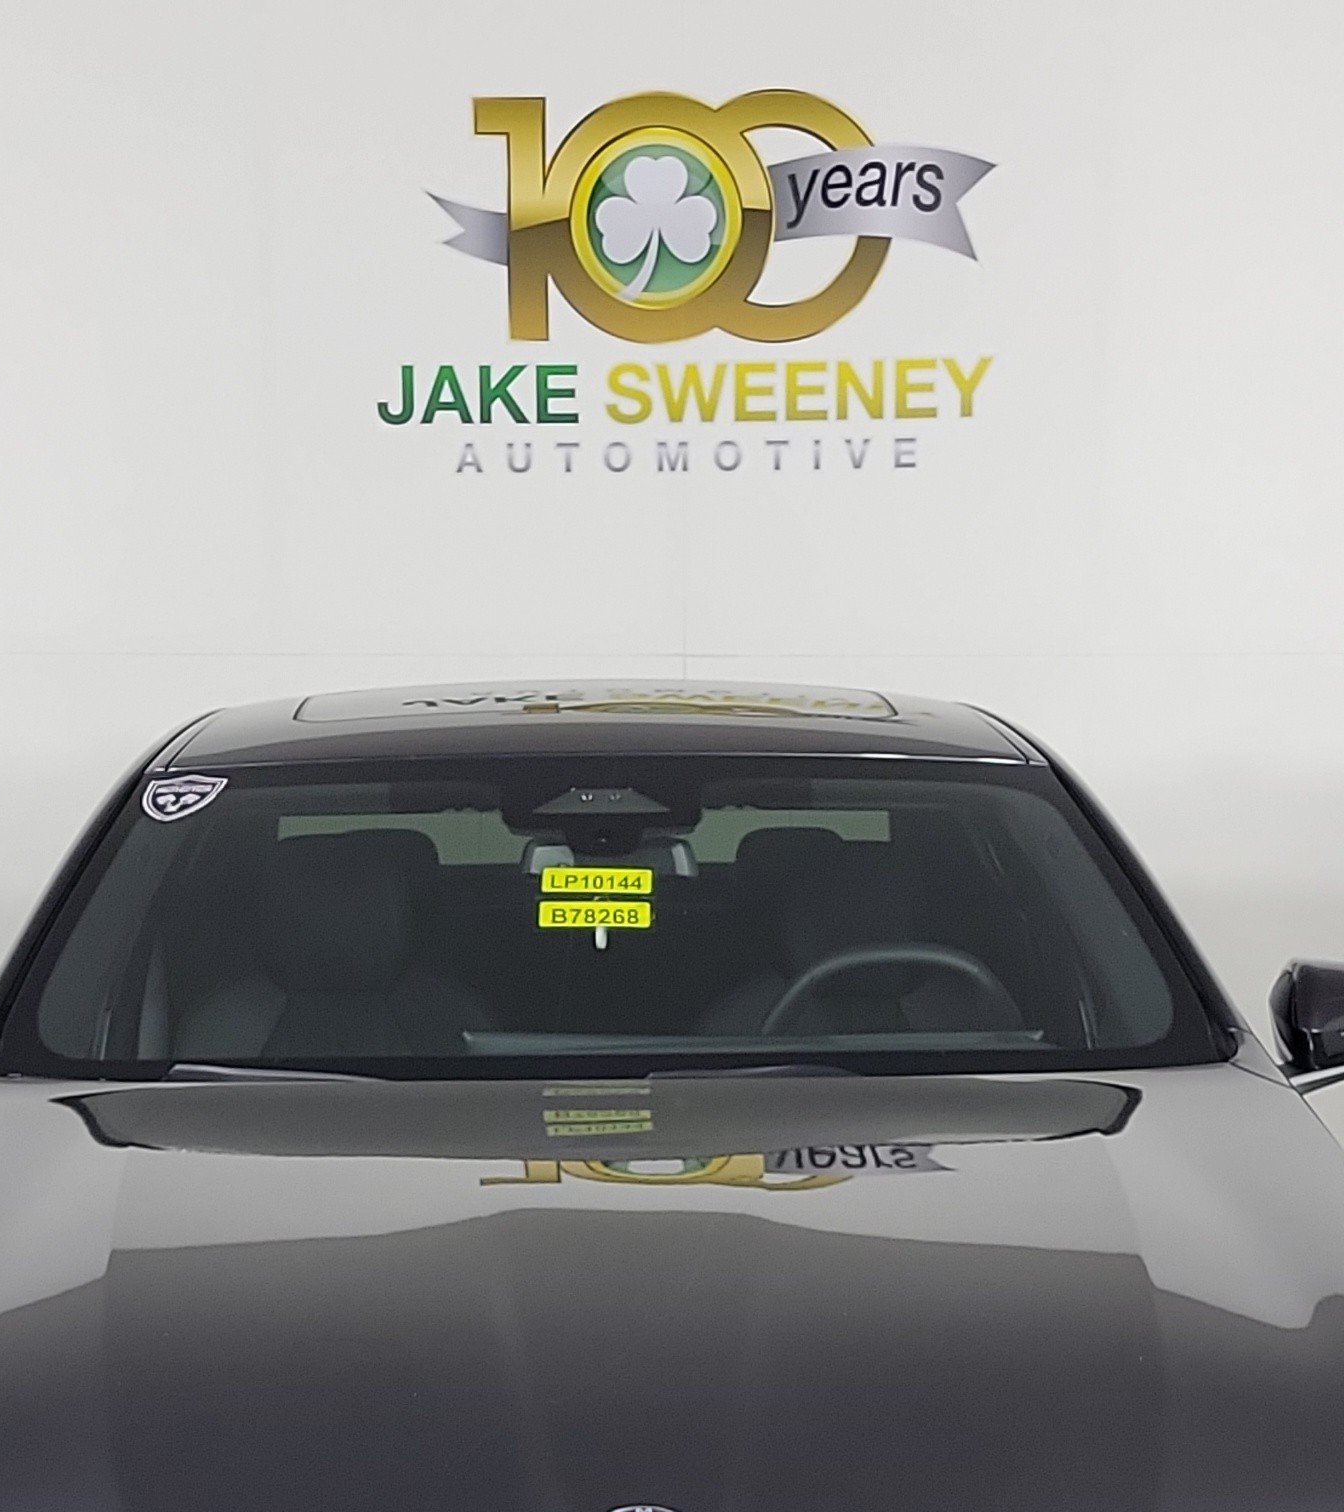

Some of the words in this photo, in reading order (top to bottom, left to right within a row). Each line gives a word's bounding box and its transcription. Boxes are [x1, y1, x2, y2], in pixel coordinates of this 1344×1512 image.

[472, 89, 893, 344] 100
[786, 158, 945, 229] years
[376, 364, 580, 425] JAKE
[604, 356, 994, 423] SWEENEY
[550, 874, 642, 890] LP10144
[551, 908, 639, 925] B78268
